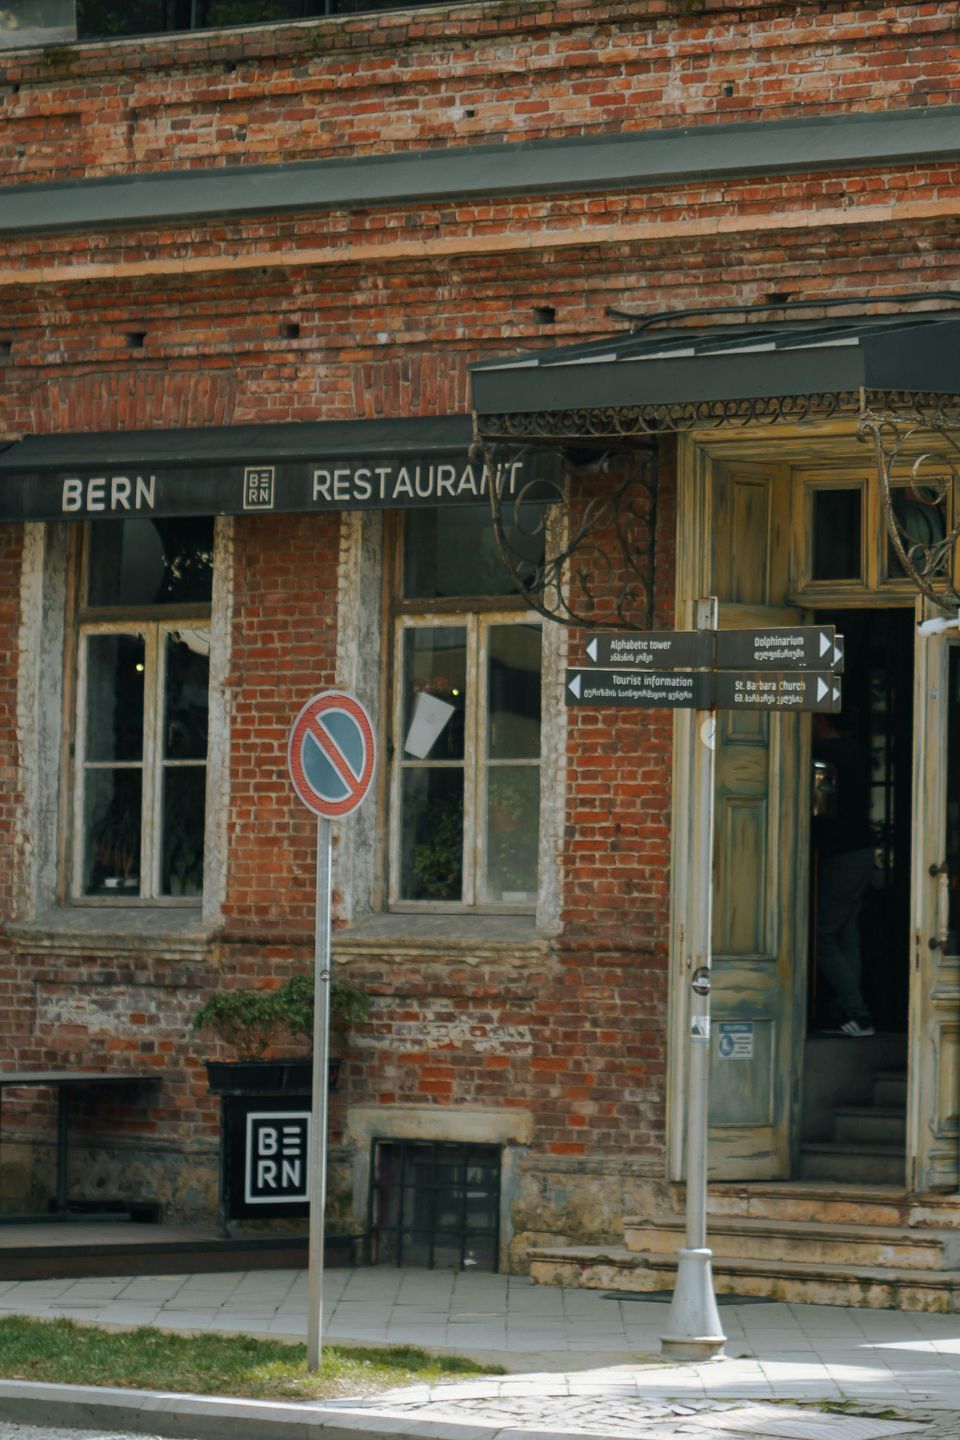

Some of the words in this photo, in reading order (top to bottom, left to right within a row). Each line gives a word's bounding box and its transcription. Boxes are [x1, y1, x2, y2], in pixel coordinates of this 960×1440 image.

[312, 462, 523, 501] RESTAURANT
[62, 475, 156, 511] BERN
[610, 640, 648, 652] Alphabetic
[649, 640, 672, 650] tower
[754, 636, 804, 648] Dolphinarium
[612, 675, 641, 686] Tourist
[643, 675, 693, 688] information
[735, 681, 745, 691] St.
[746, 680, 777, 691] Barbara
[778, 680, 806, 691] Church
